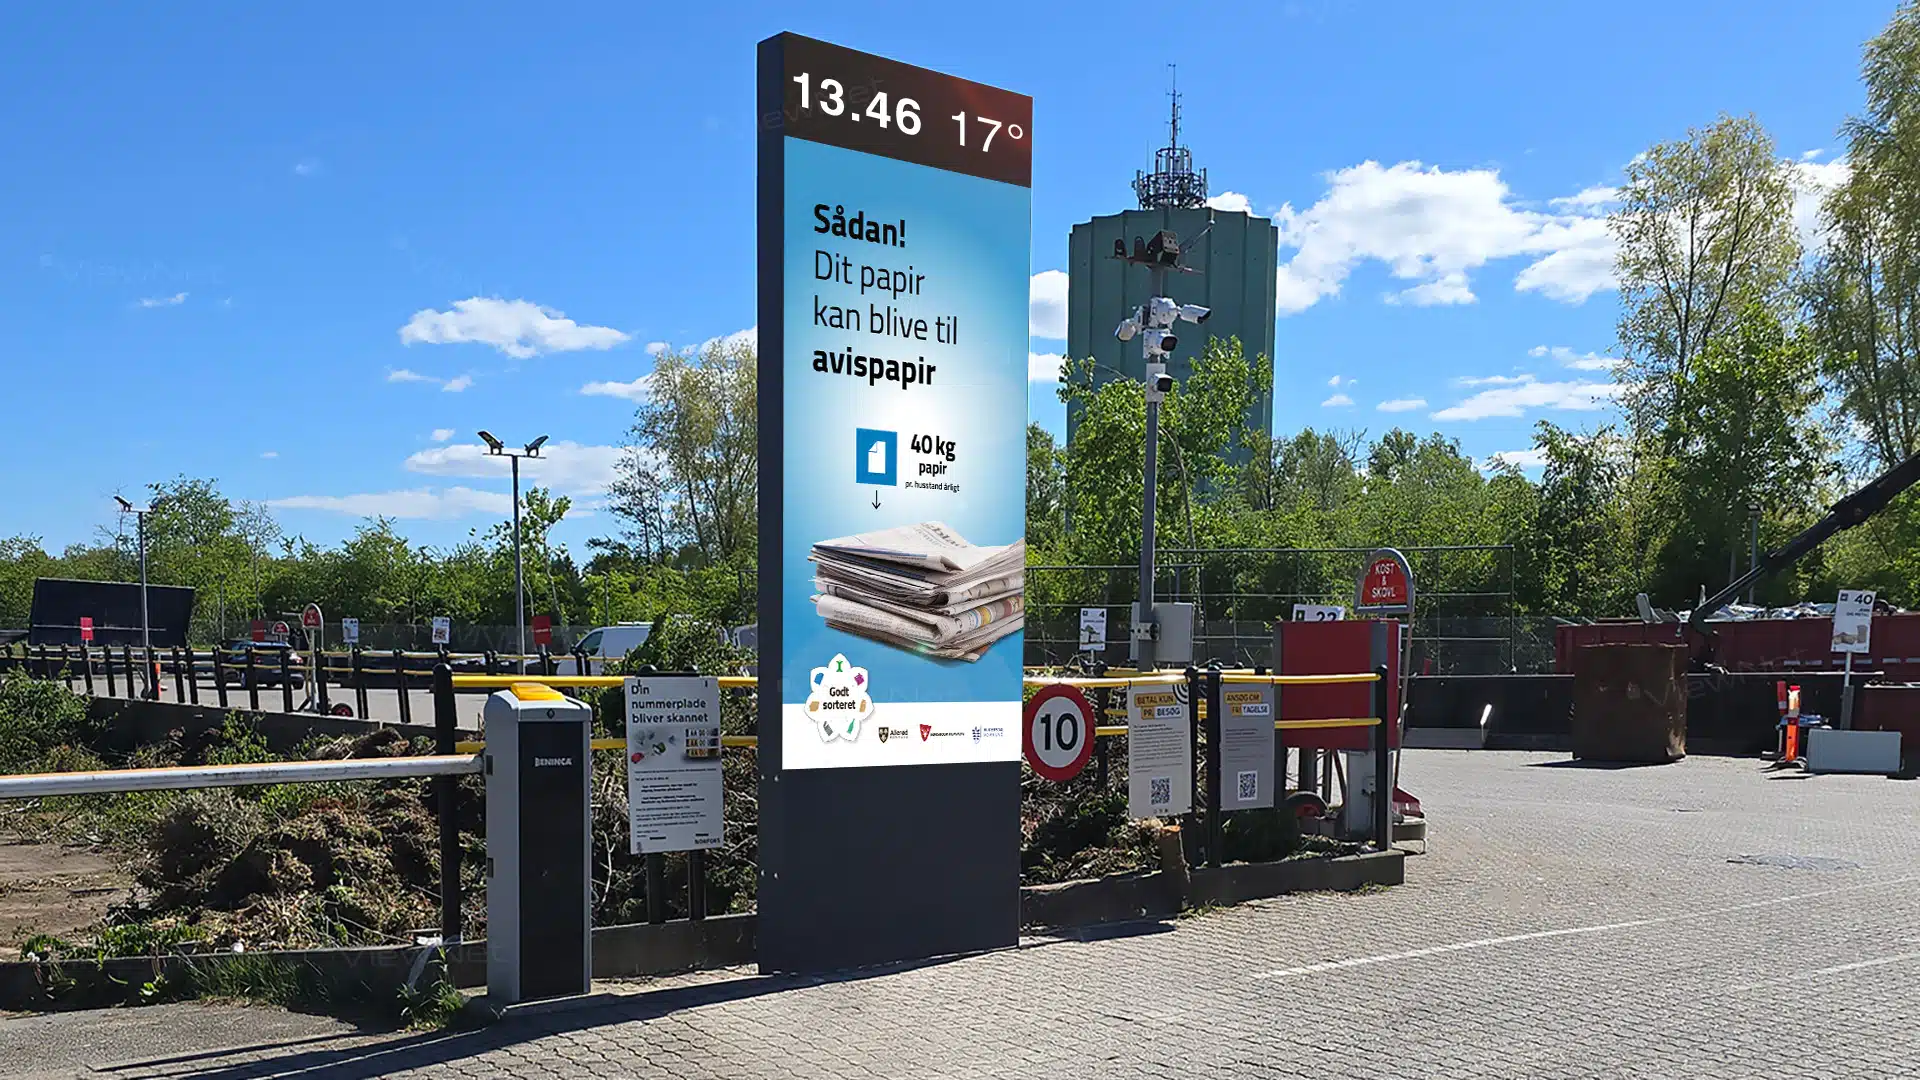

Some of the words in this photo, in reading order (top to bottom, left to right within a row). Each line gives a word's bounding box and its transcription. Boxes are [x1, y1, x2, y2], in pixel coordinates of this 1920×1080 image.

[793, 72, 922, 136] 13.46
[813, 203, 906, 248] Sådan!
[815, 250, 853, 285] Dit
[860, 265, 926, 300] papir
[814, 295, 861, 331] kan
[870, 303, 928, 341] blive
[935, 316, 958, 345] til
[812, 347, 936, 390] avispapir
[910, 434, 932, 454] 40
[936, 435, 956, 462] kg
[919, 461, 948, 477] papir
[905, 481, 914, 489] pr.
[914, 480, 943, 492] husstand
[943, 482, 960, 493] årligt
[1374, 563, 1396, 575] KOST
[1371, 587, 1396, 599] SKOVL
[1855, 594, 1873, 605] 40
[631, 684, 650, 696] Din
[829, 686, 850, 697] Godt
[631, 699, 706, 711] nummerplade
[823, 700, 856, 710] sorteret
[632, 714, 664, 724] bliver
[666, 712, 708, 724] skannet
[1040, 713, 1078, 750] 10
